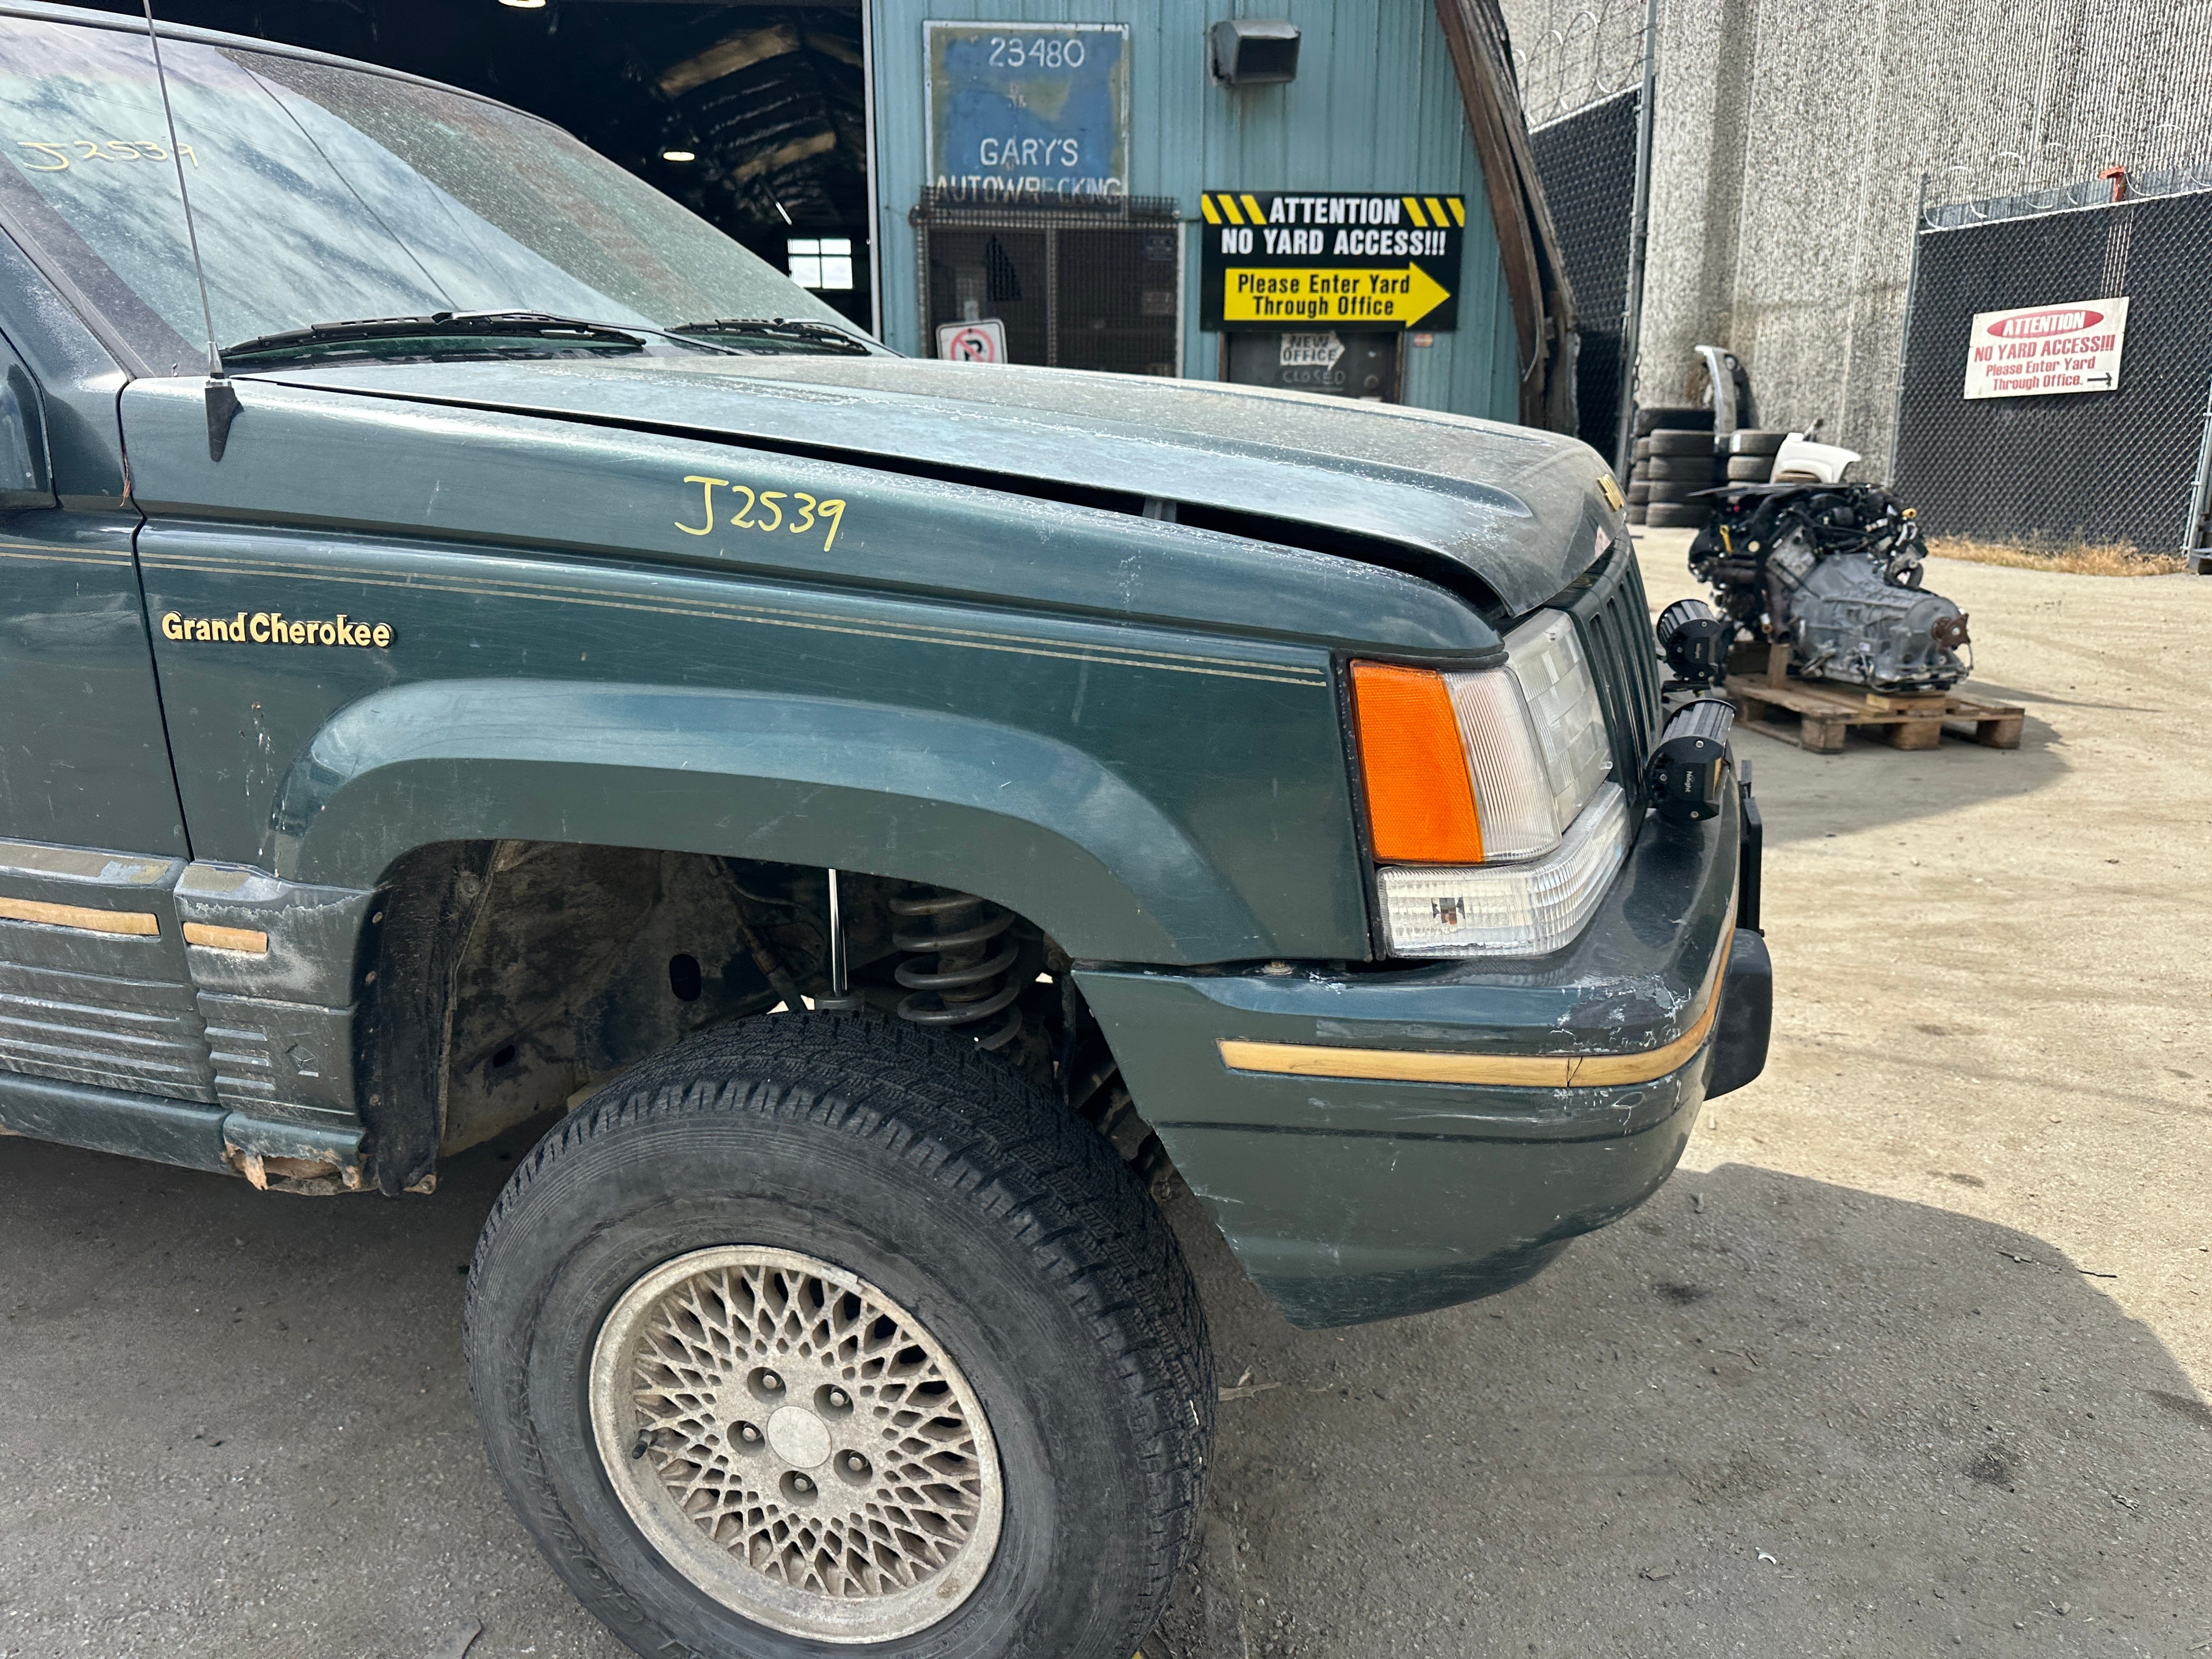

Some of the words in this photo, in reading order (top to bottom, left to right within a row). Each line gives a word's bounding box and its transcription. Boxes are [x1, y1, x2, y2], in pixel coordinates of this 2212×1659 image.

[988, 37, 1085, 67] 23480
[17, 140, 199, 171] J2539
[980, 138, 1079, 167] GARY'S
[1268, 197, 1400, 224] ATTENTION
[1221, 228, 1253, 255] NO
[1263, 229, 1324, 255] YARD
[1333, 230, 1446, 256] ACCESS!!!
[1237, 274, 1300, 293] Please
[1309, 274, 1360, 293] Enter
[1370, 274, 1410, 294] Yard
[1253, 296, 1328, 319] Through
[1338, 296, 1394, 316] Office
[2002, 311, 2086, 336] ATTENTION
[1283, 347, 1338, 361] OFFICE
[1974, 346, 1993, 363] NO
[1998, 342, 2037, 360] YARD
[2040, 334, 2116, 357] ACCESS!!!
[1986, 364, 2022, 377] Please
[2025, 360, 2059, 373] Enter
[2064, 356, 2096, 370] Yard
[1993, 375, 2040, 391] Through
[674, 475, 847, 552] J2539
